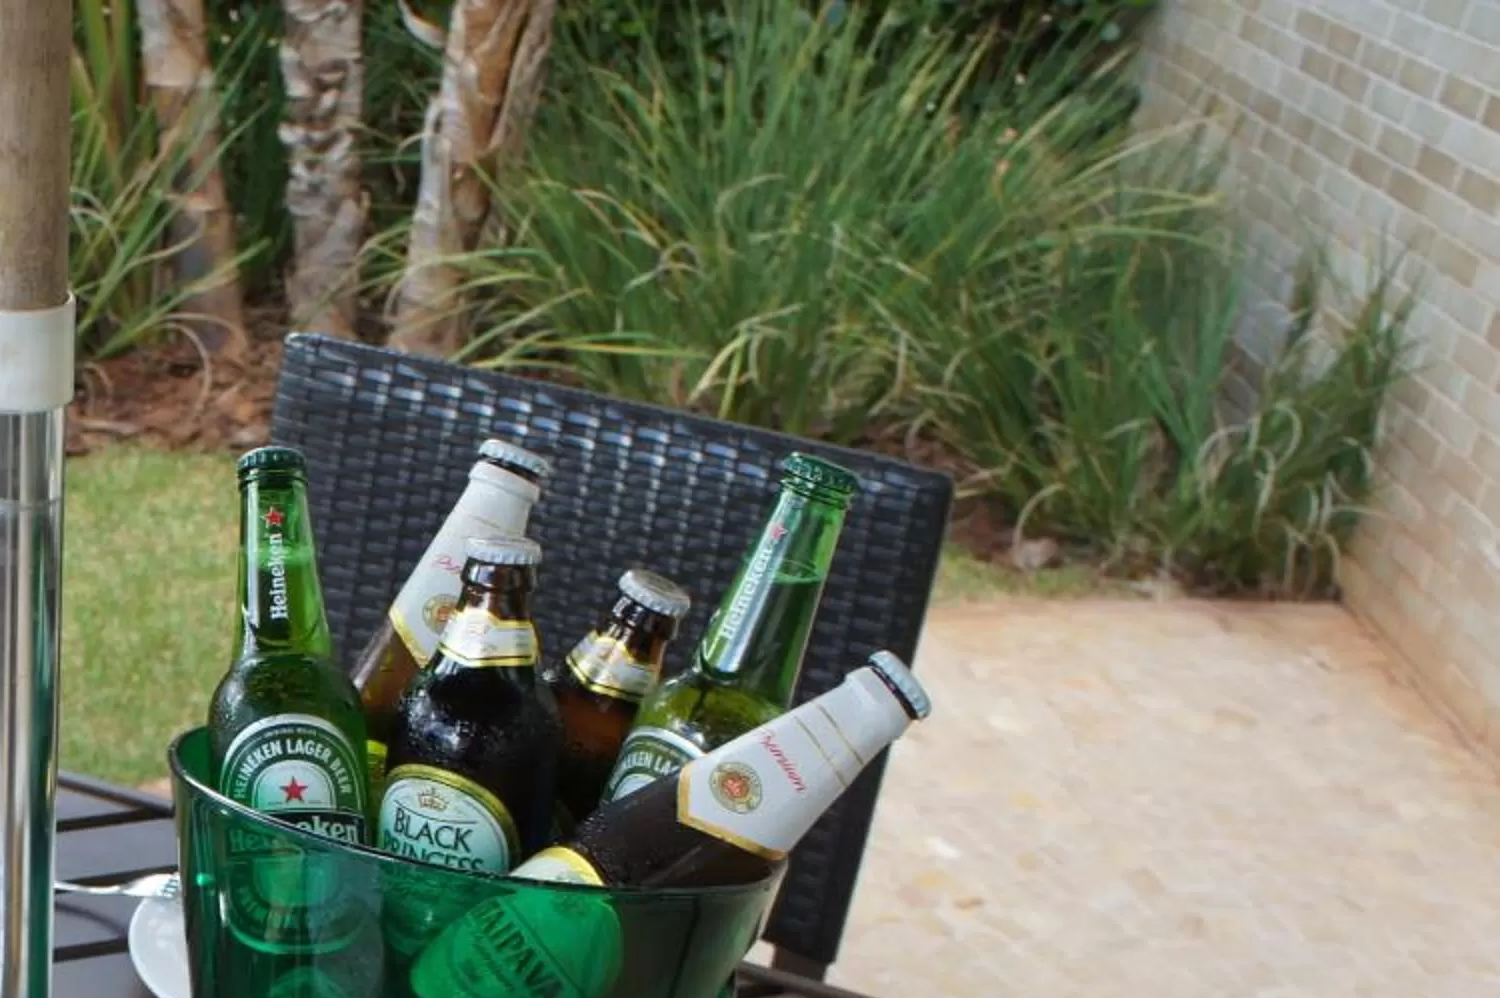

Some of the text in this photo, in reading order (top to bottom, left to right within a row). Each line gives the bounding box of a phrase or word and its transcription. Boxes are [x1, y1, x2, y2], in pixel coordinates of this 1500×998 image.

[268, 532, 290, 620] Heineken
[719, 543, 774, 640] Heineken
[233, 737, 353, 799] HEINEKEN LAGER BEER
[393, 807, 474, 853] BLACK
